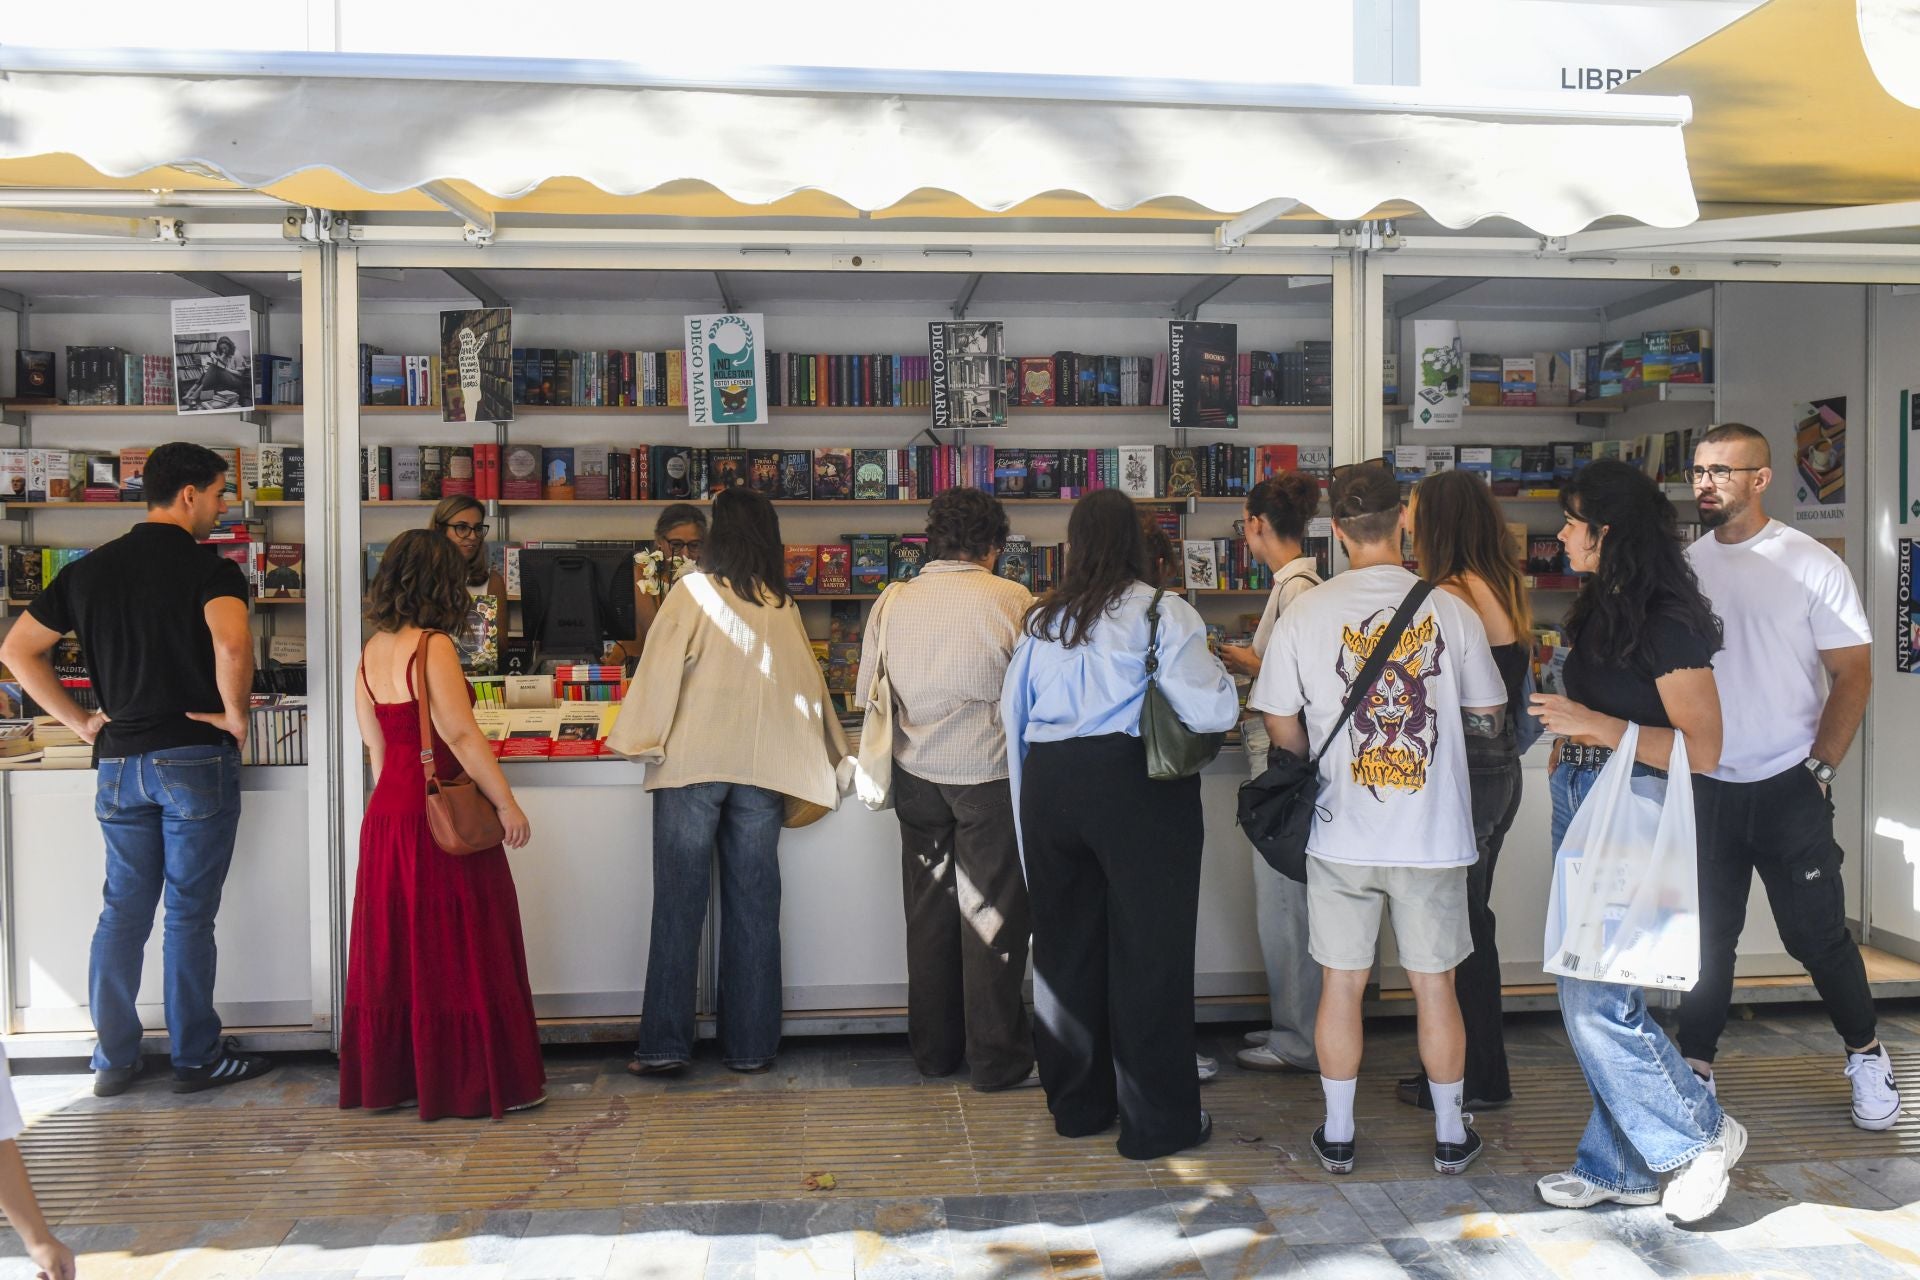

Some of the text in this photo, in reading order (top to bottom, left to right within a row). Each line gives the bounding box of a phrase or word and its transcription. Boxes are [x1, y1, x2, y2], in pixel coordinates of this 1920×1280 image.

[1204, 352, 1225, 362] BOOKS
[690, 319, 709, 424] DIEGO MARÍN
[931, 323, 948, 427] DIEGO MARÍN
[1171, 325, 1184, 424] Librero Editor
[1299, 453, 1327, 464] AQUA
[1796, 508, 1845, 521] DIEGO MARÍN
[897, 548, 920, 558] DIOSES
[1533, 542, 1560, 554] 1973
[1898, 541, 1911, 671] DIEGO MARÍN
[558, 618, 586, 627] DELL
[54, 665, 88, 673] MALDITA
